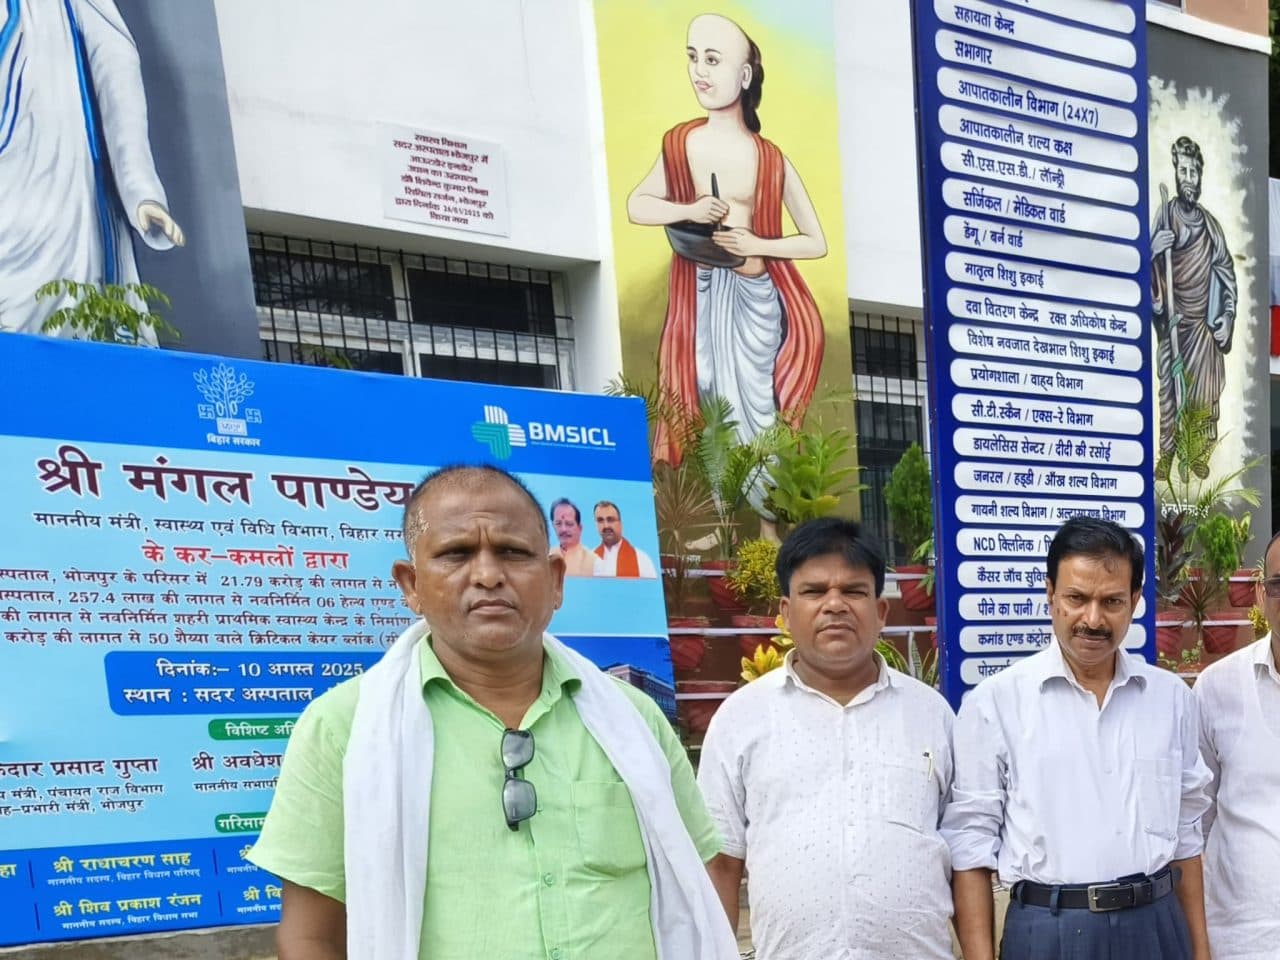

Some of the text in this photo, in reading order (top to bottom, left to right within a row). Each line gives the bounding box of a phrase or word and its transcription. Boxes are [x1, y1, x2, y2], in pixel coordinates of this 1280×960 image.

[954, 5, 991, 28] सहायता
[954, 40, 993, 65] सभागार
[958, 80, 1023, 111] आपातकालीन
[1026, 90, 1059, 116] विभाग
[959, 118, 1073, 156] आपातकालीन शल्य कक्ष
[962, 187, 1066, 224] सर्जिकल मेडिकल वार्ड
[1008, 230, 1023, 248] वार्ड
[1019, 269, 1044, 288] इकाई
[965, 297, 1067, 325] दवा वितरण रक्त
[967, 328, 1116, 365] विशेष नवजात देखभाल शिशु इकाई
[970, 364, 1084, 391] प्रयोगशाला विभाग
[1066, 409, 1093, 426] विभाग
[528, 421, 617, 447] BMSICL
[973, 434, 1087, 459] डायलेसिस दीदी की
[37, 445, 415, 512] श्री मंगल पाण्डेय
[973, 470, 1118, 490] जनरल शल्य विभाग
[971, 500, 1047, 518] गायनी शल्य विभाग
[34, 510, 335, 541] माननीय स्वास्थ्य एवं विधि विभाग,
[973, 536, 996, 551] NCD
[998, 532, 1034, 552] क्लिनिक
[142, 540, 165, 562] के
[303, 551, 348, 569] द्वारा
[63, 567, 118, 588] भोजपुर
[123, 568, 137, 584] के
[143, 569, 191, 586] परिसर
[195, 571, 207, 585] में
[221, 575, 263, 587] 21.79
[309, 574, 325, 588] की
[331, 579, 367, 590] लागत
[372, 576, 383, 590] से
[69, 590, 336, 608] 257.4 लाख की लागत से नवनिर्मित 06
[978, 598, 995, 616] पीने
[998, 602, 1010, 616] का
[1013, 597, 1033, 616] पानी
[28, 608, 411, 628] लागत से नवनिर्मित शहरी प्राथमिक स्वास्थ्य केन्द्र के निर्माण
[4, 627, 302, 646] करोड़ की लागत से 50 वाले क्रिटिकल
[978, 631, 1024, 646] कमांड एण्ड
[238, 663, 261, 677] 10
[268, 662, 314, 677] अगस्त
[321, 663, 364, 677] 2025
[123, 687, 314, 704] स्थान सदर अस्पताल
[225, 722, 270, 737] विशिष्ट
[50, 758, 159, 779] प्रसाद गुप्ता
[192, 751, 282, 770] श्री अवधेश
[47, 782, 164, 799] पंचायत राज विभाग
[194, 779, 238, 791] माननीय
[100, 798, 145, 813] भोजपुर
[53, 852, 192, 873] श्री राधाचरण साह
[243, 886, 261, 901] श्री
[53, 893, 202, 917] श्री शिव प्रकाश रंजन
